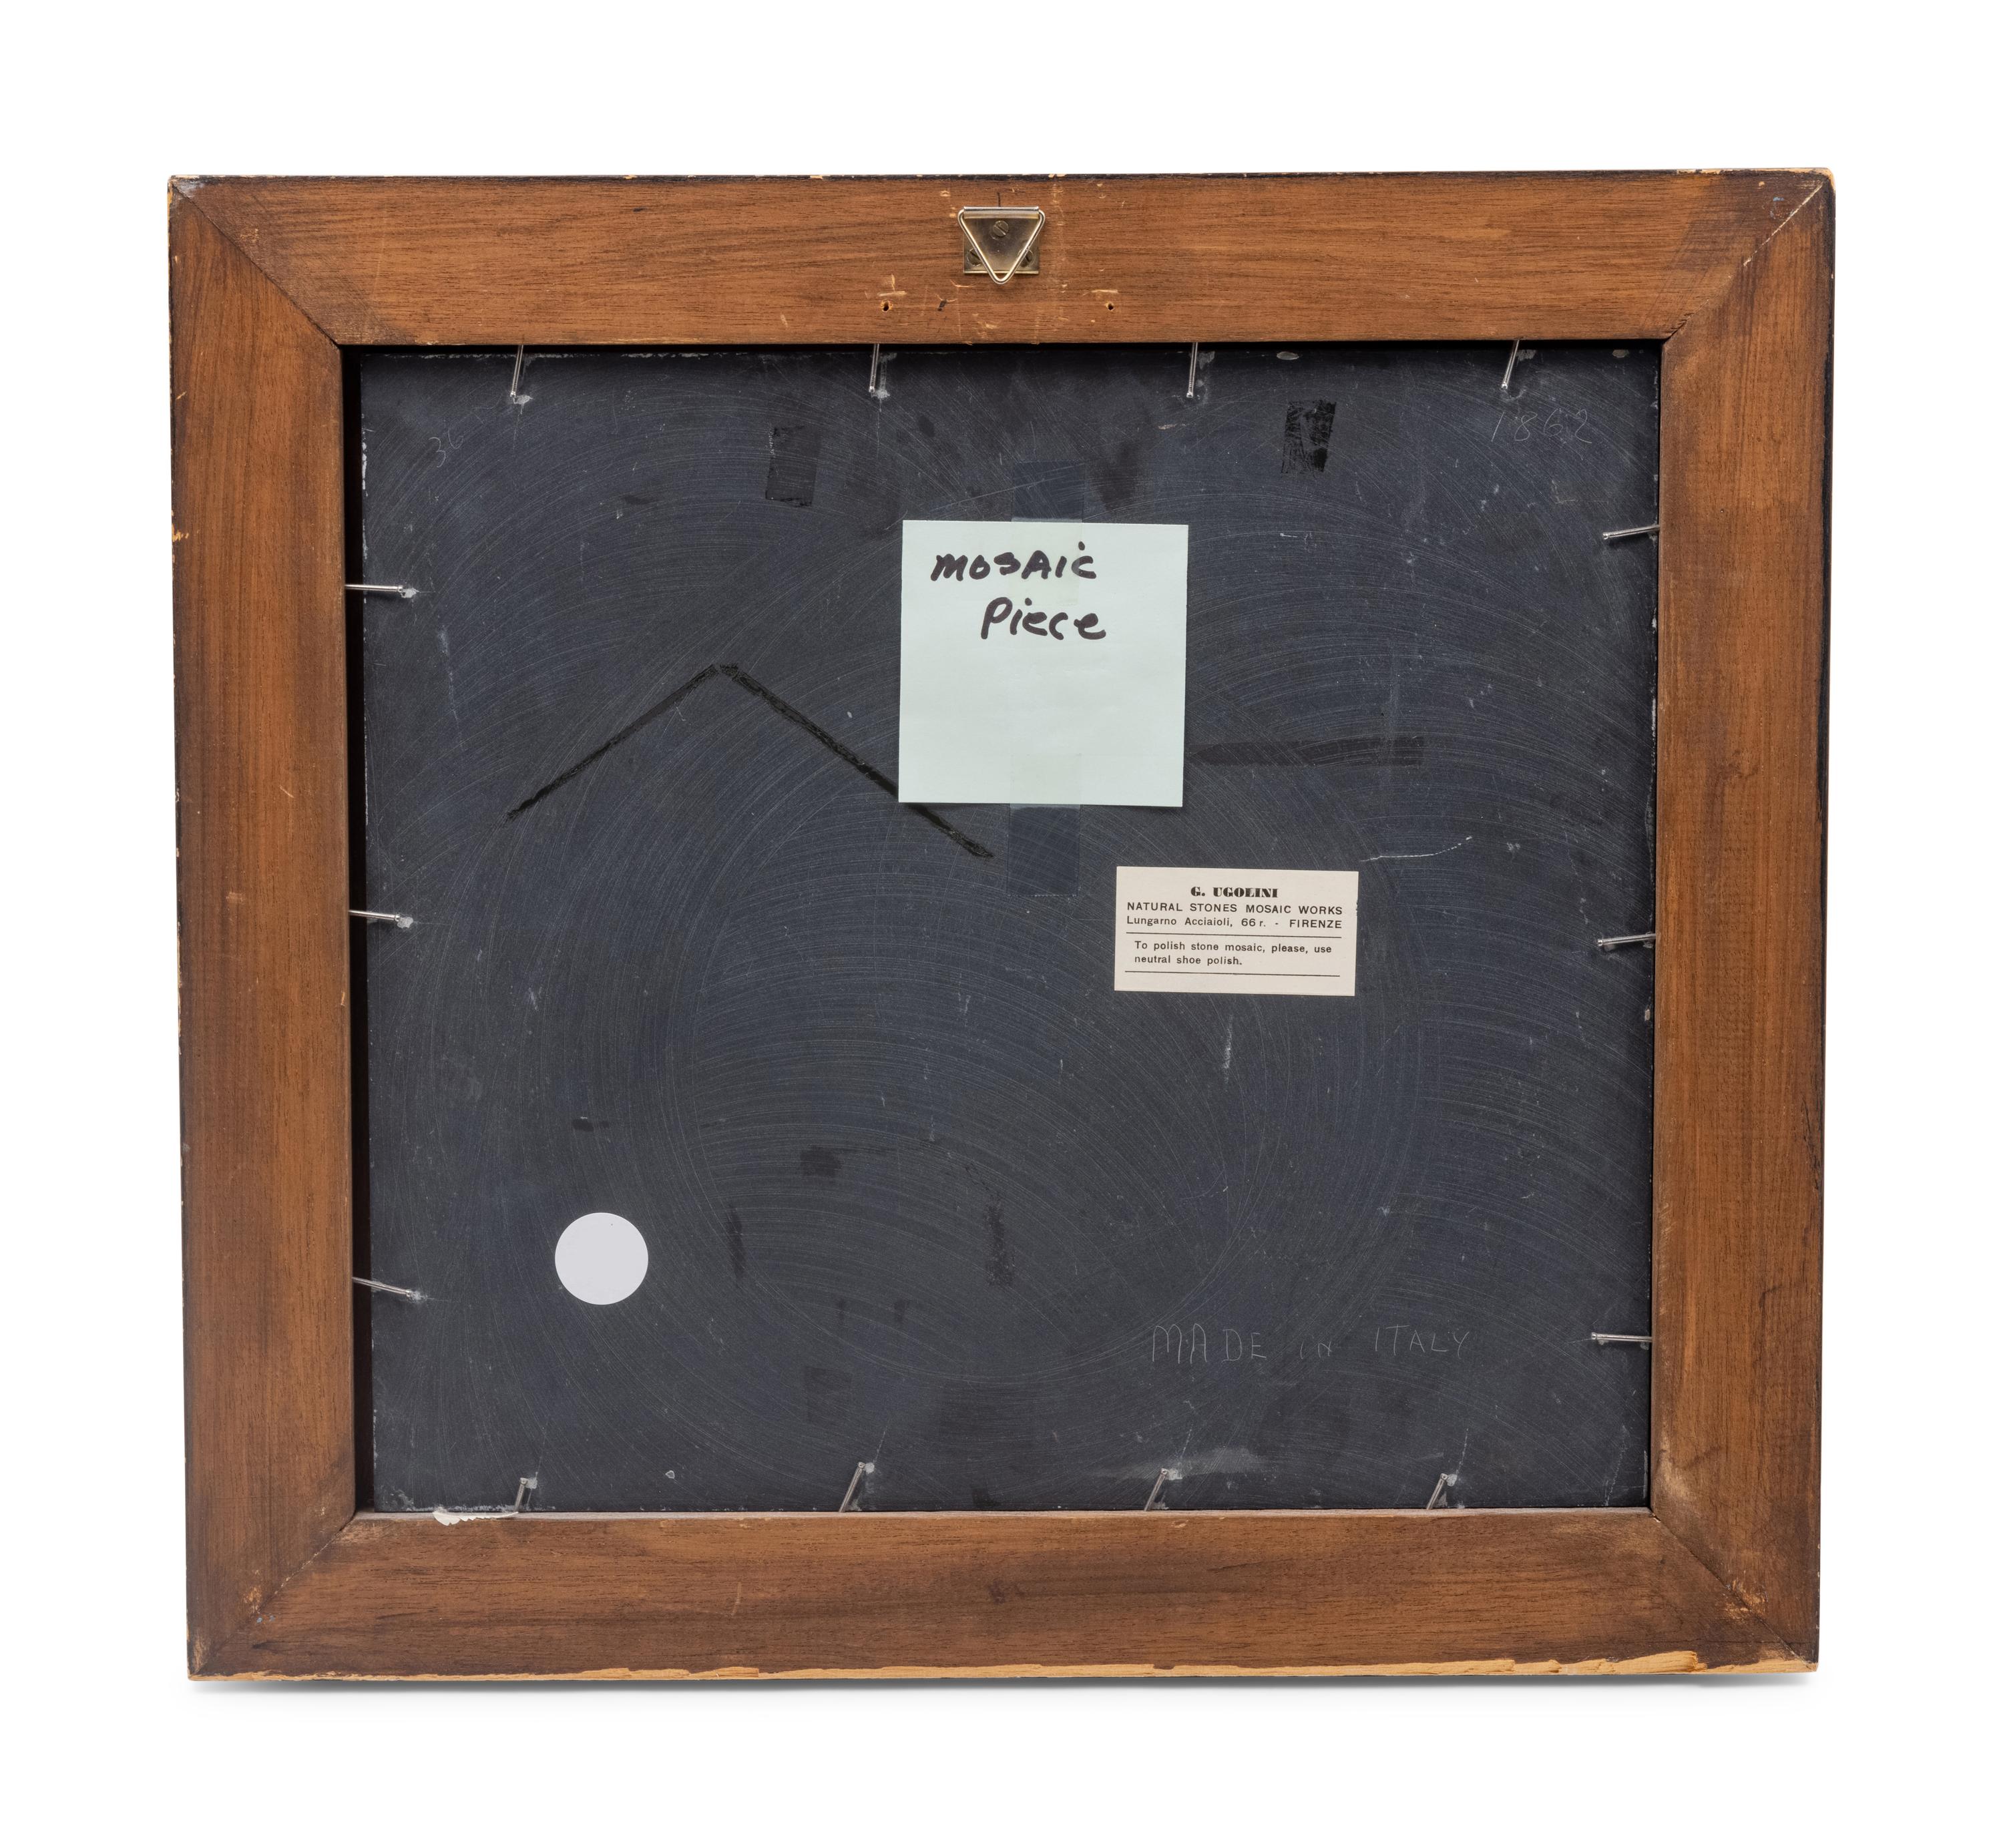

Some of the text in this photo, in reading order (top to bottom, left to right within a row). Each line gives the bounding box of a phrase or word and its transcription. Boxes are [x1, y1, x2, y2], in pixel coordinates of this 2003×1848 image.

[1490, 408, 1592, 443] 1862
[1191, 887, 1277, 897] G. UGOLINI
[1128, 902, 1342, 915] NATURAL STONES MOSAIC WORKS
[1127, 916, 1176, 926] Lungarno
[1185, 917, 1232, 927] Acciaioli,
[1290, 919, 1341, 928] FIRENZE
[1135, 941, 1147, 949] To
[1154, 941, 1184, 951] polish
[1225, 943, 1265, 953] mosaic,
[1272, 944, 1307, 953] please,
[1208, 957, 1242, 965] polish.
[1152, 1323, 1267, 1364] MADE
[1375, 1325, 1470, 1358] ITALY
